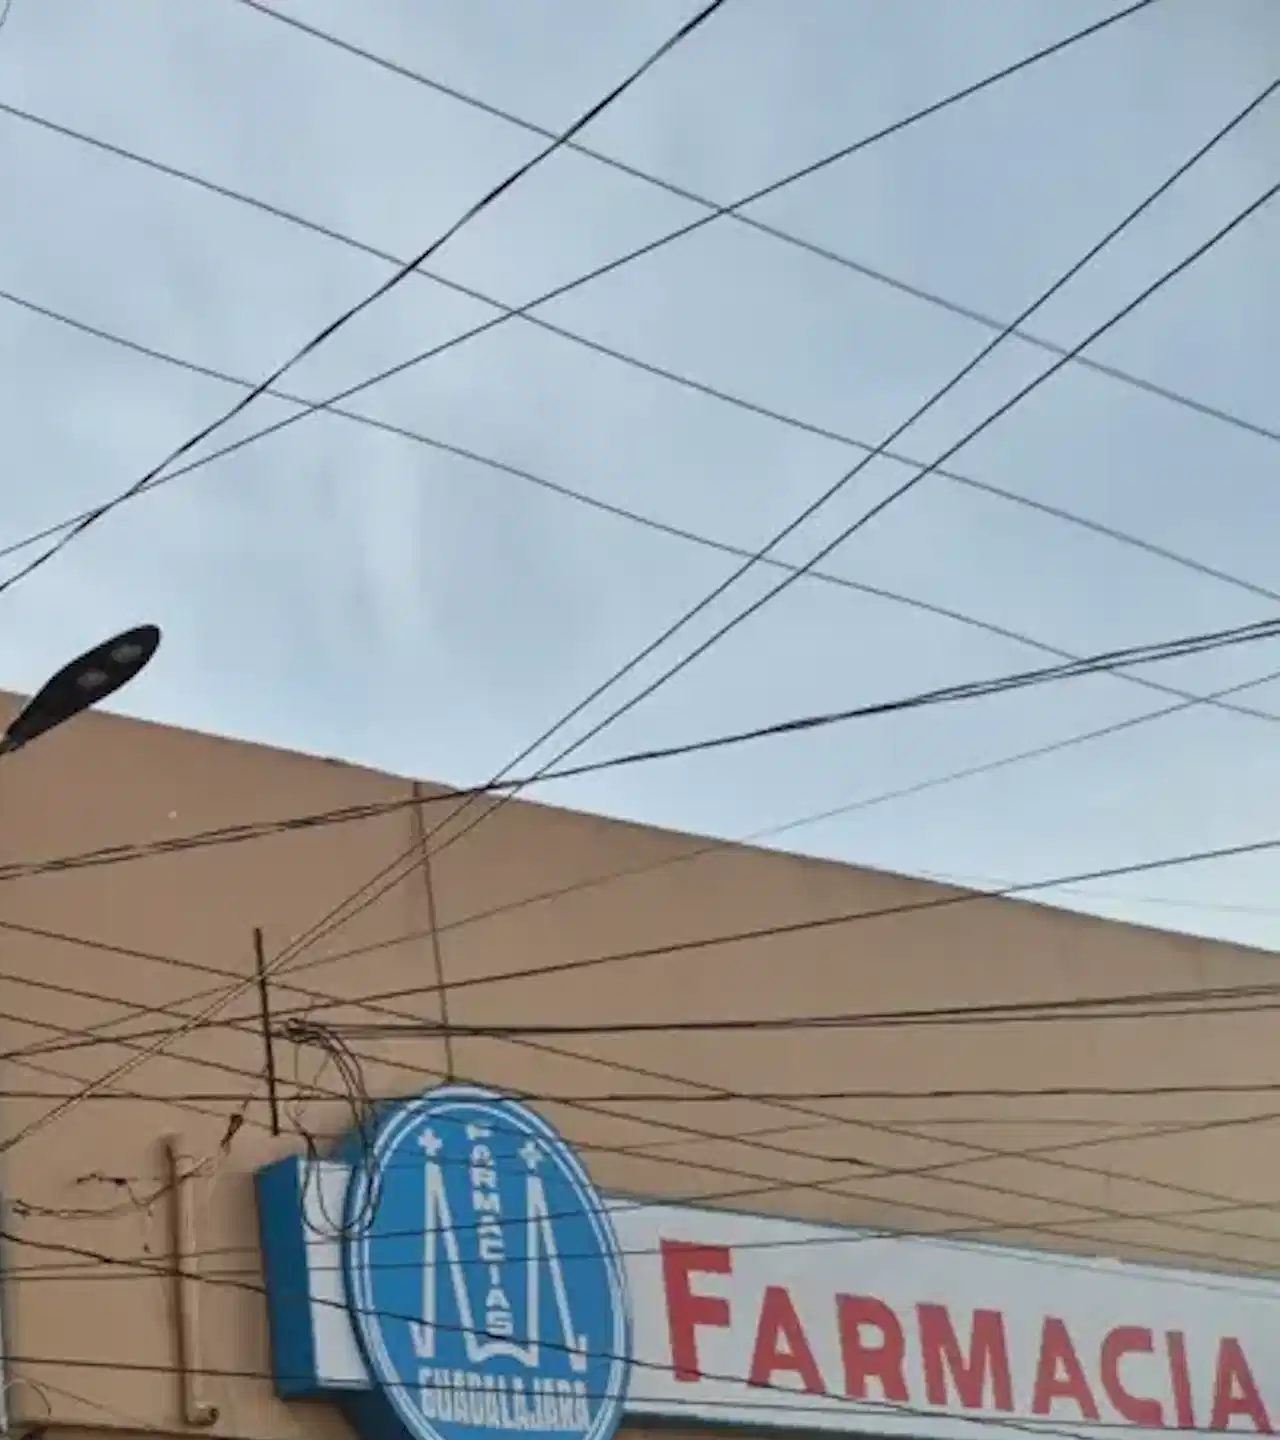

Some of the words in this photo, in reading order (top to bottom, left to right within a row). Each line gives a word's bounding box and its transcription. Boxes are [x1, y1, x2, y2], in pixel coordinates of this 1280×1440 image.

[465, 1123, 513, 1336] FARMACIAS
[418, 1366, 592, 1431] GUADALAJARA
[660, 1239, 1278, 1435] FARMACIA
